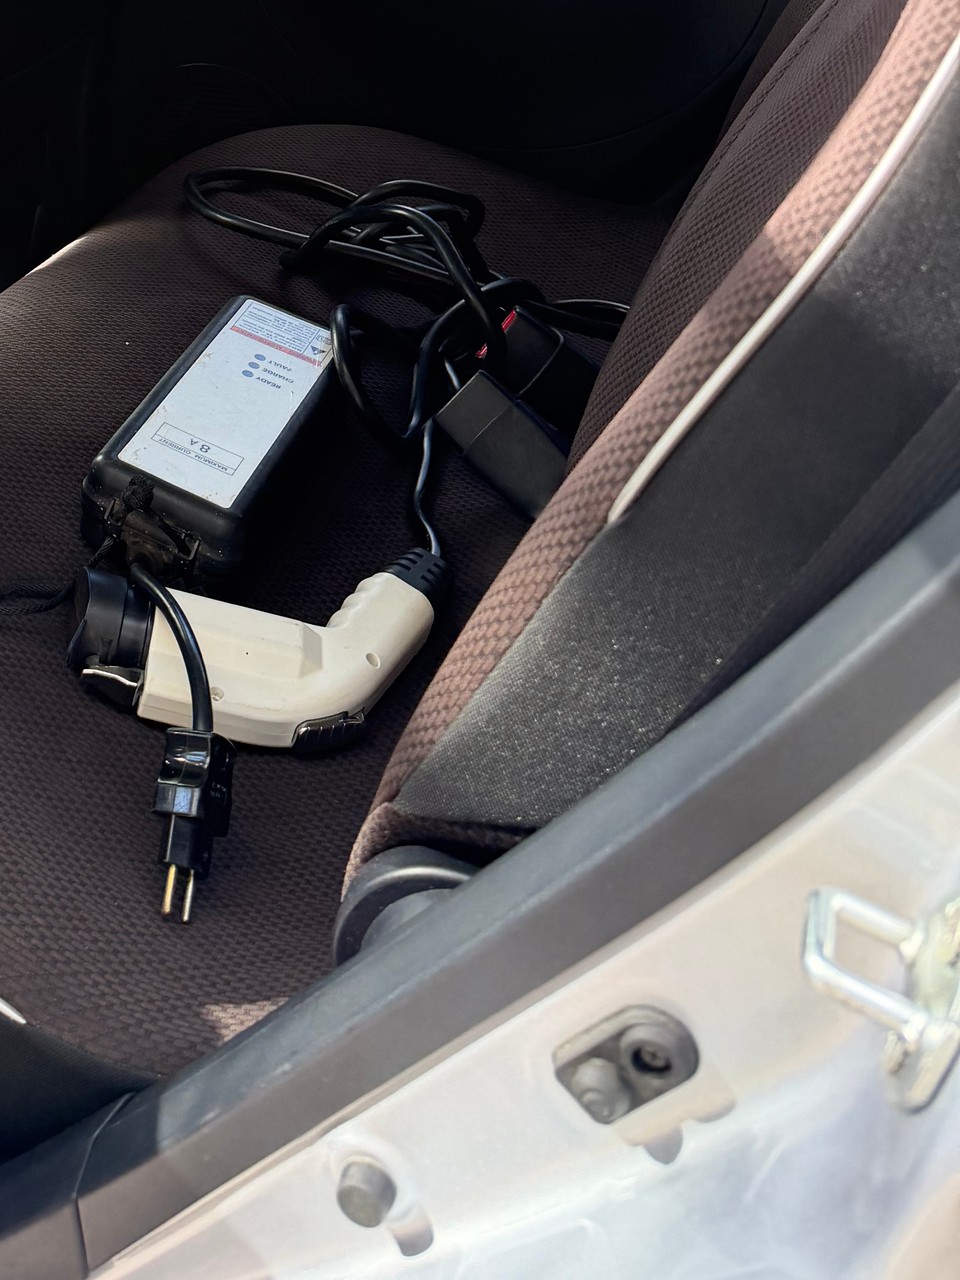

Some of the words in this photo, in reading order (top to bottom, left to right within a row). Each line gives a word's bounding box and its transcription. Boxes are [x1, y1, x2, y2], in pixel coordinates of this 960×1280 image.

[256, 376, 282, 389] READY
[262, 367, 294, 384] CHARGE
[159, 437, 192, 455] CURRENT
[194, 454, 228, 472] MAXIMUM
